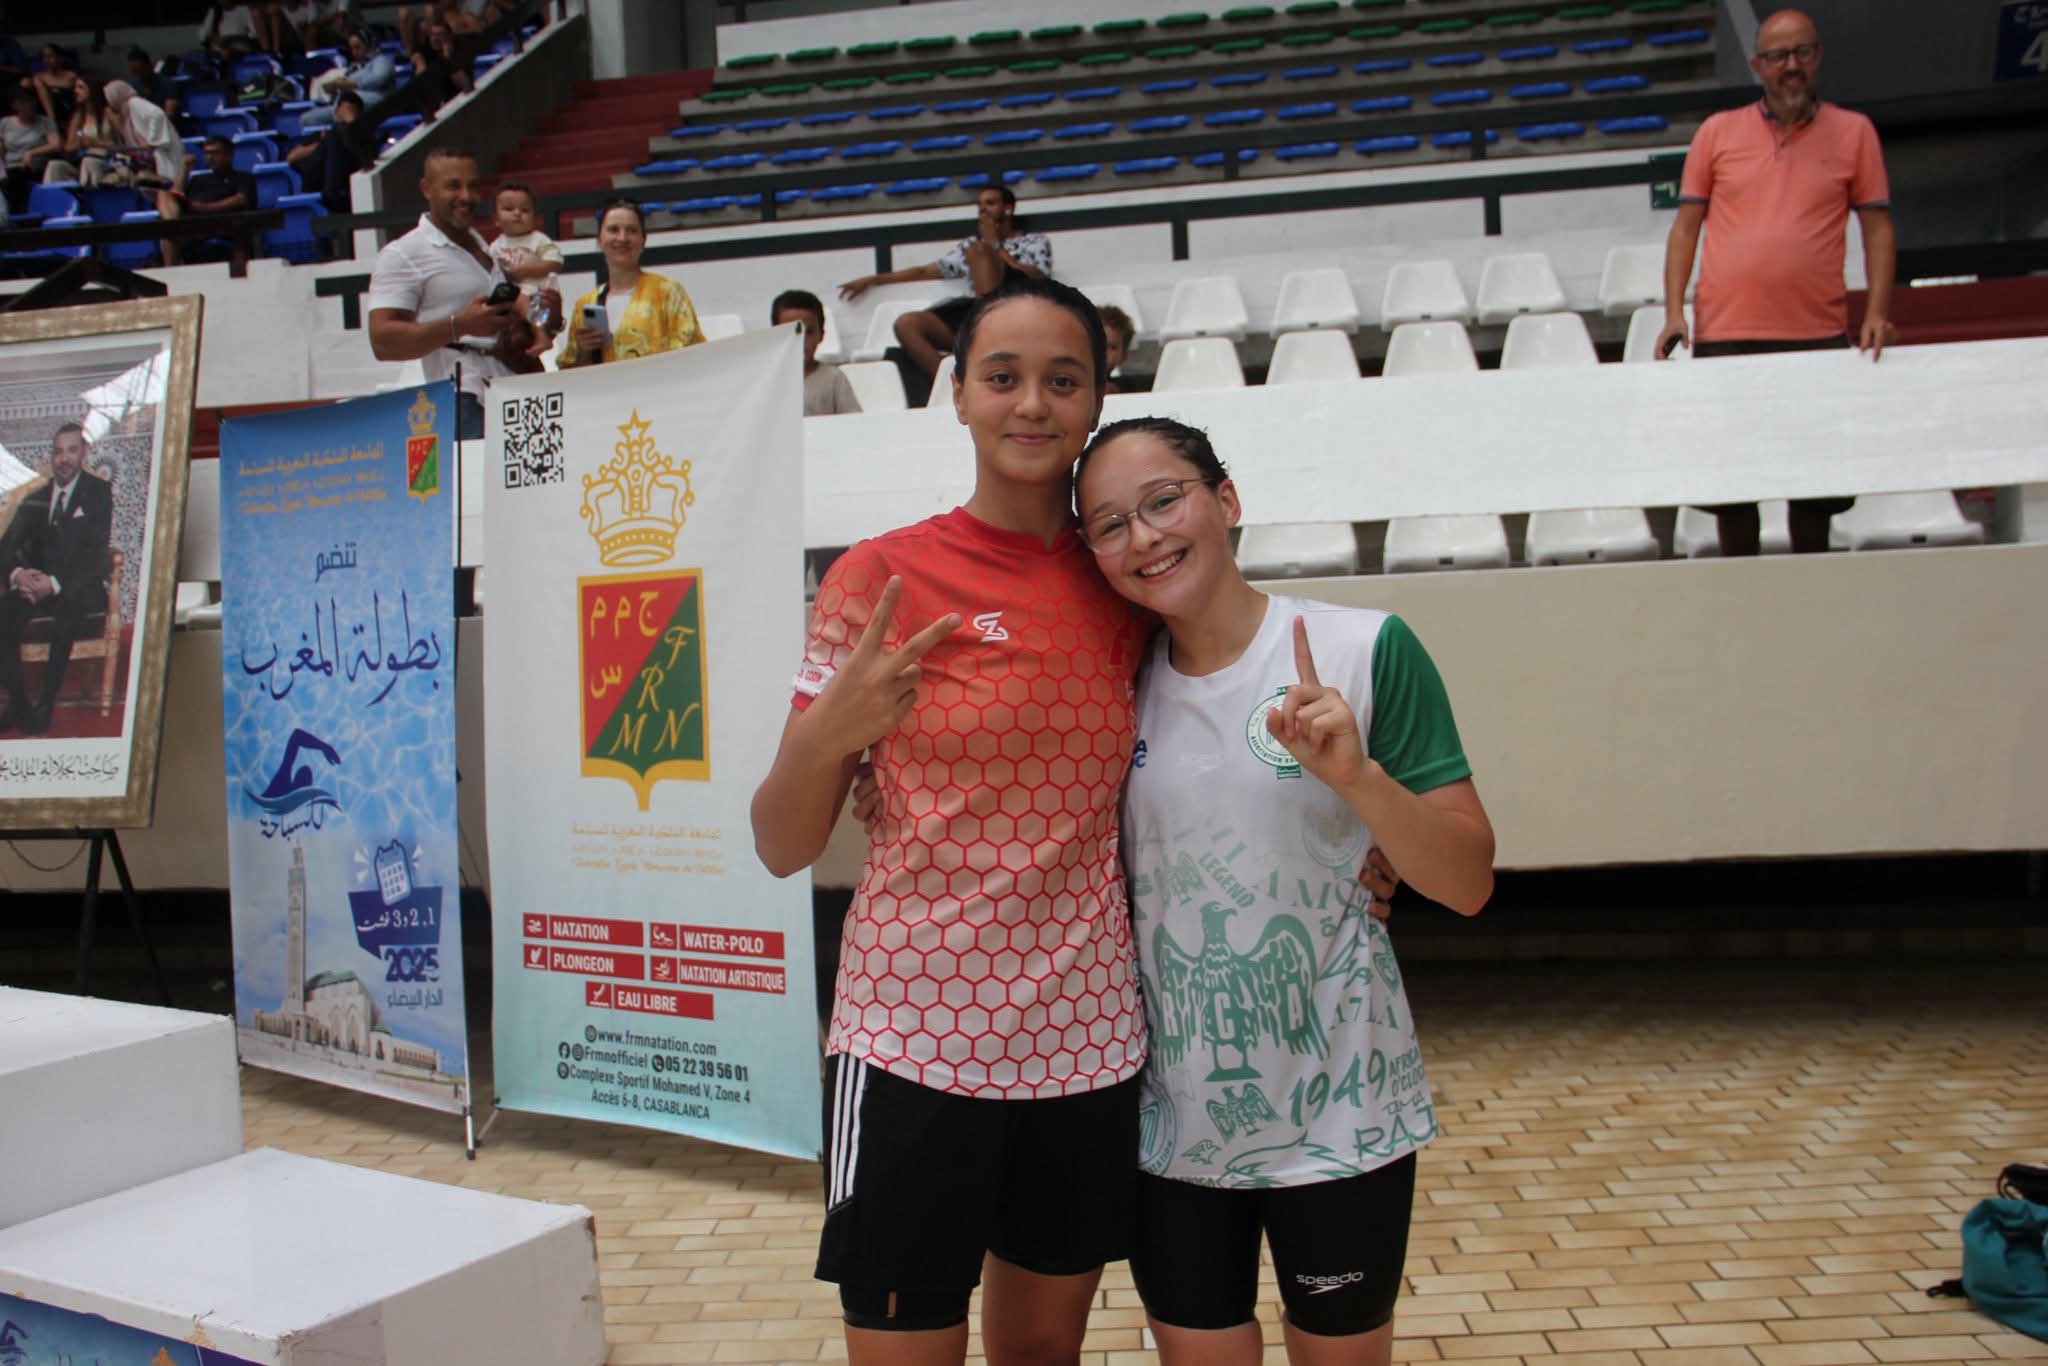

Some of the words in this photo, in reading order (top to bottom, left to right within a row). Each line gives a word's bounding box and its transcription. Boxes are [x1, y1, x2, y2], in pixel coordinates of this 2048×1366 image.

[241, 597, 340, 700] المغرب
[345, 590, 441, 708] بطولة
[1197, 851, 1256, 909] LEGEND
[553, 921, 609, 941] NATATION
[683, 932, 764, 954] WATER-POLO
[384, 947, 440, 982] 2025
[553, 954, 614, 973] PLONGEON
[680, 964, 726, 984] NATATION
[727, 969, 785, 990] ARTISTIQUE
[618, 991, 641, 1008] EAU
[643, 994, 678, 1013] LIBRE
[598, 1030, 717, 1056] www.frmnatation.com
[584, 1046, 648, 1067] Frmnofficiel
[665, 1055, 680, 1073] 05
[683, 1058, 697, 1075] 22
[699, 1060, 715, 1078] 39
[716, 1063, 732, 1080] 56
[734, 1065, 749, 1082] 01
[569, 1064, 615, 1084] Complexe
[617, 1070, 649, 1090] Sportif
[652, 1075, 700, 1097] Mohamed
[703, 1084, 713, 1101] V,
[715, 1085, 741, 1103] Zone
[743, 1089, 751, 1104] 4
[1289, 1048, 1388, 1128] 1949
[643, 1097, 710, 1120] CASABLANCA
[1296, 1271, 1365, 1287] speedo
